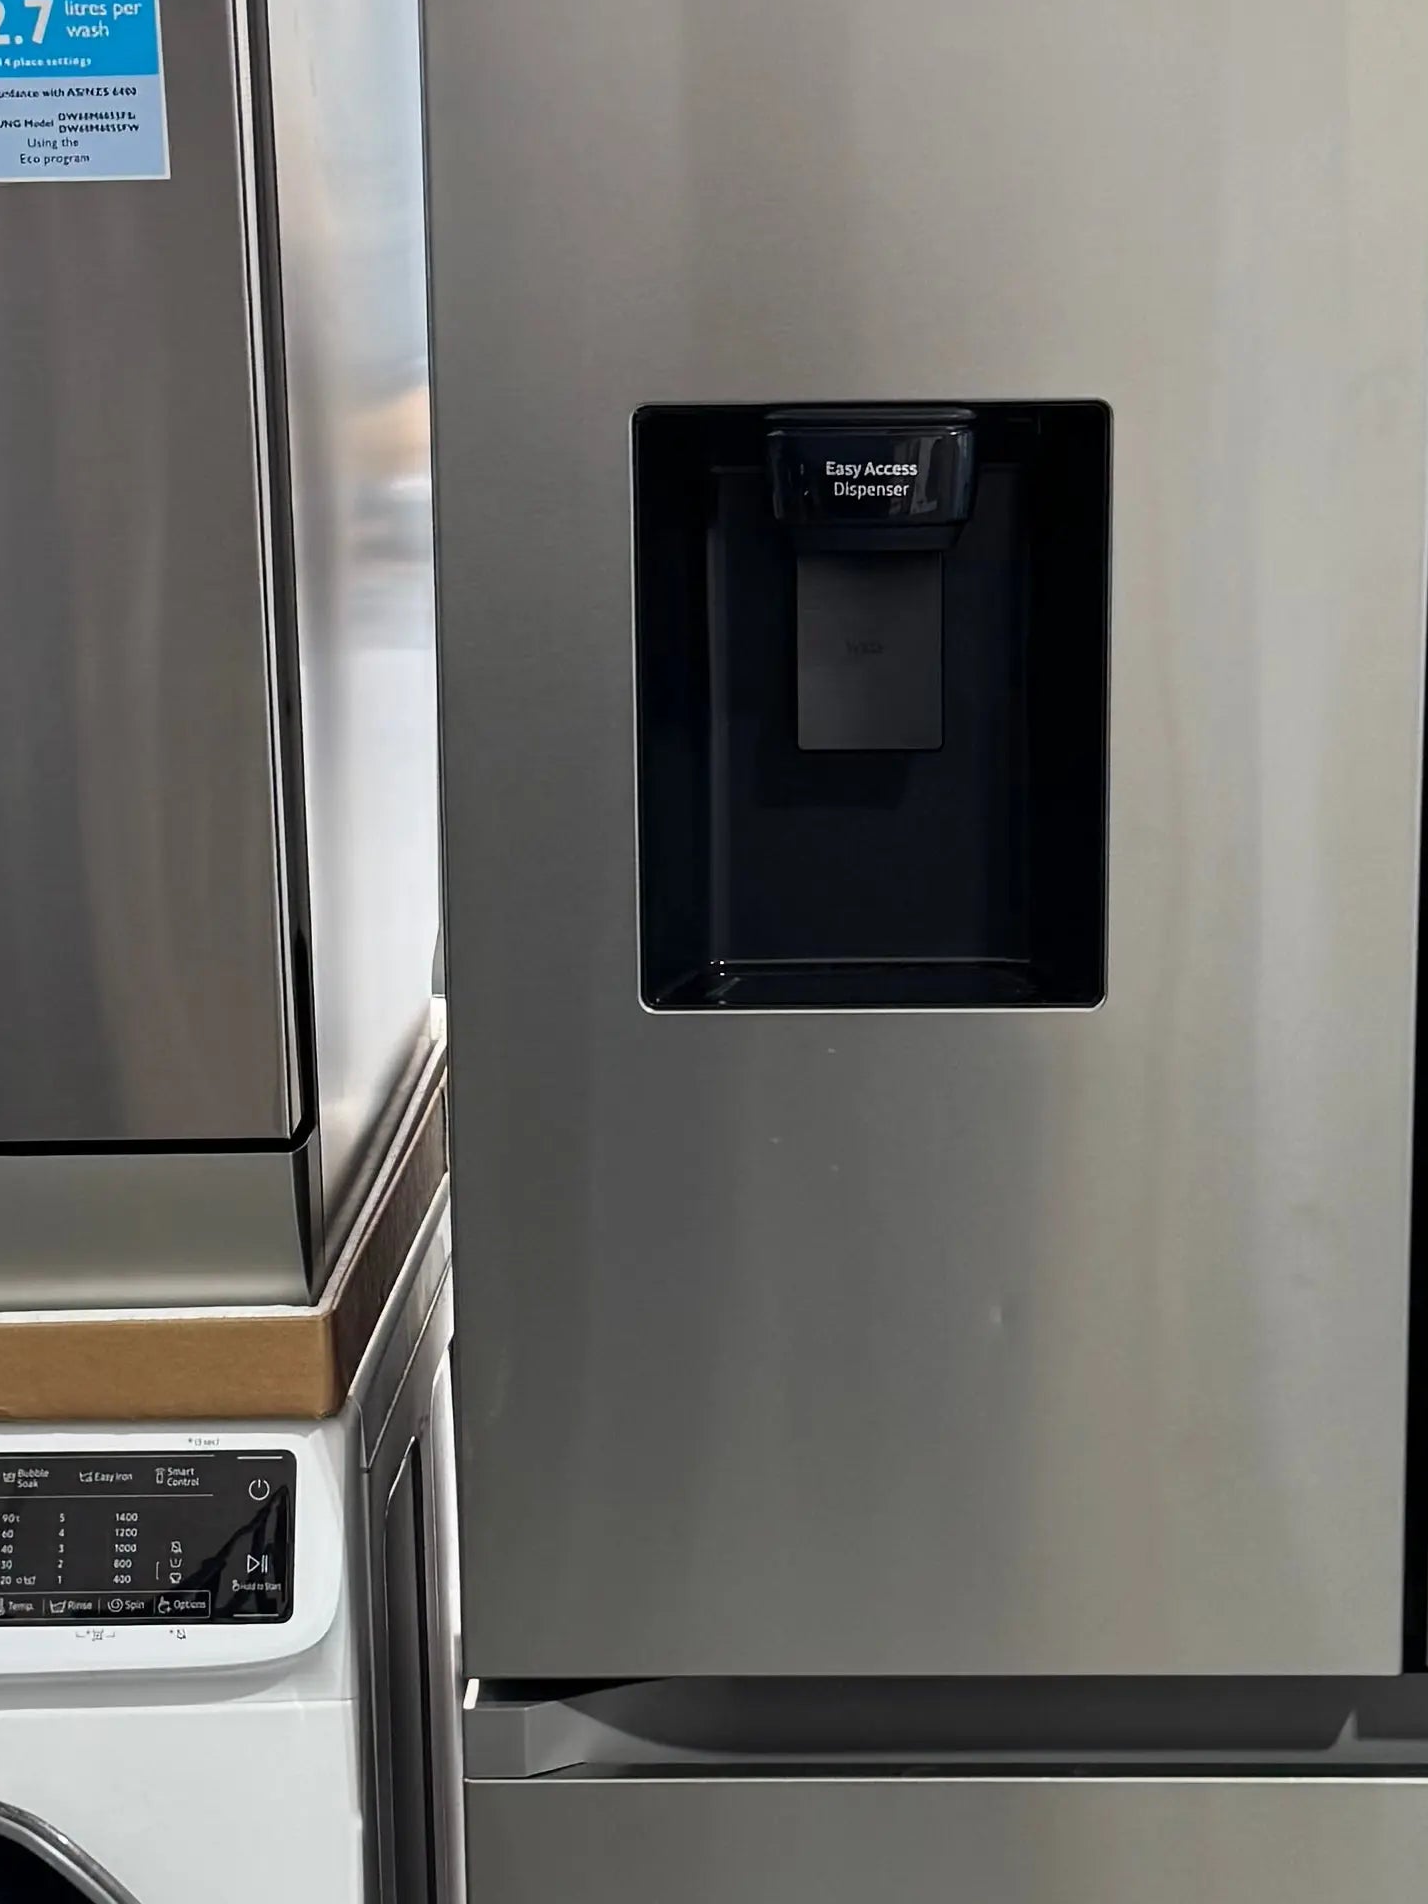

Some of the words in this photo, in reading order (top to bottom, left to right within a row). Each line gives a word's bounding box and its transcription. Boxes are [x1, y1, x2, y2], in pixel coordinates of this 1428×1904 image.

[64, 0, 107, 16] litres
[112, 2, 142, 20] per
[66, 20, 110, 38] wash
[12, 56, 44, 69] place
[46, 56, 92, 68] settings
[41, 87, 65, 98] with
[24, 118, 54, 128] Model
[27, 138, 58, 149] Using
[61, 137, 79, 147] the
[20, 153, 41, 164] Eco
[44, 154, 90, 166] program
[826, 461, 862, 479] Easy
[864, 461, 918, 476] Access
[834, 481, 909, 500] Dispenser
[17, 1468, 50, 1478] Bubble
[94, 1472, 115, 1483] Easy
[115, 1472, 133, 1481] Iron
[167, 1467, 195, 1477] Smart
[17, 1479, 38, 1488] Soak
[167, 1477, 200, 1487] Control
[59, 1513, 65, 1523] 5
[115, 1512, 139, 1523] 1400
[1, 1529, 14, 1539] 60
[58, 1528, 65, 1537] 4
[115, 1528, 138, 1538] 1200
[0, 1545, 13, 1554] 40
[58, 1544, 65, 1553] 3
[114, 1544, 137, 1553] 1000
[0, 1560, 13, 1570] 30
[58, 1559, 64, 1569] 2
[113, 1559, 132, 1569] 800
[0, 1576, 12, 1585] 20
[113, 1575, 132, 1584] 400
[8, 1601, 34, 1612] Temp.
[67, 1600, 93, 1610] Rinse
[124, 1599, 145, 1611] Spin
[173, 1599, 207, 1610] Options
